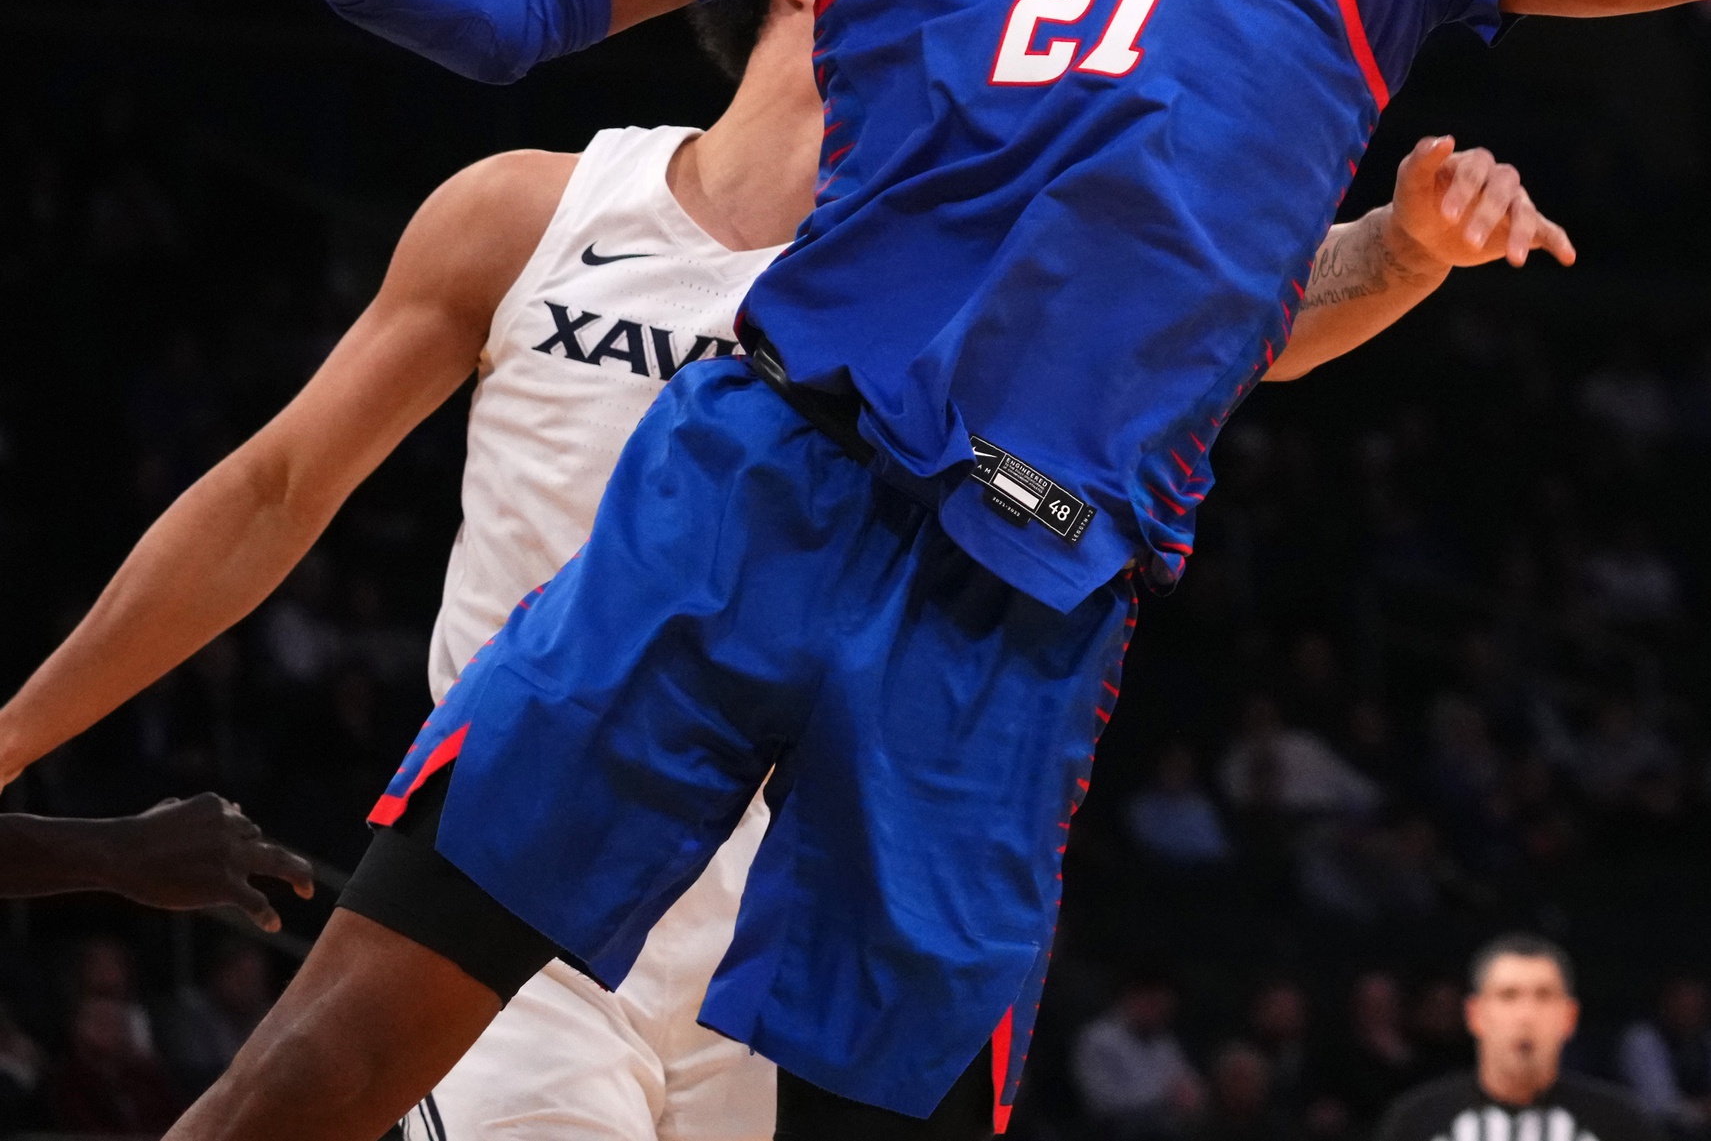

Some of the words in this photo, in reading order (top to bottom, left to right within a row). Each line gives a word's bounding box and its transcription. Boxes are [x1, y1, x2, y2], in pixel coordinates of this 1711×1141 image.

[532, 301, 739, 381] XAV
[1006, 457, 1048, 487] ENGINEERED
[1048, 500, 1071, 521] 48
